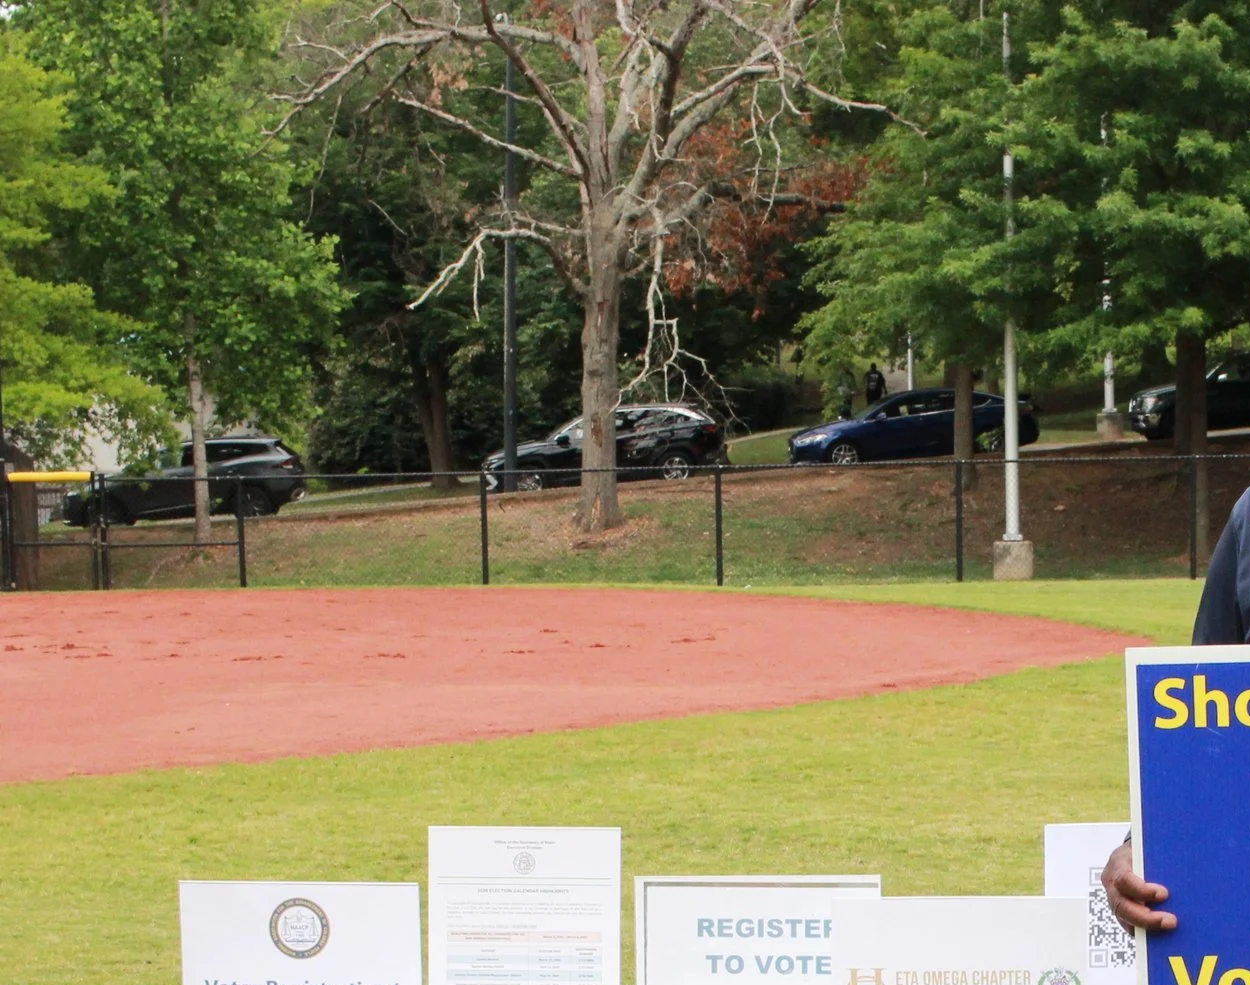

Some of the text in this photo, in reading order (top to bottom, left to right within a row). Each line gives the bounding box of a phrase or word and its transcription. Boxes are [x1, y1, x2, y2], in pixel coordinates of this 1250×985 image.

[705, 954, 832, 975] TO VOTE
[923, 970, 968, 985] OMEGA
[972, 969, 1031, 985] CHAPTER
